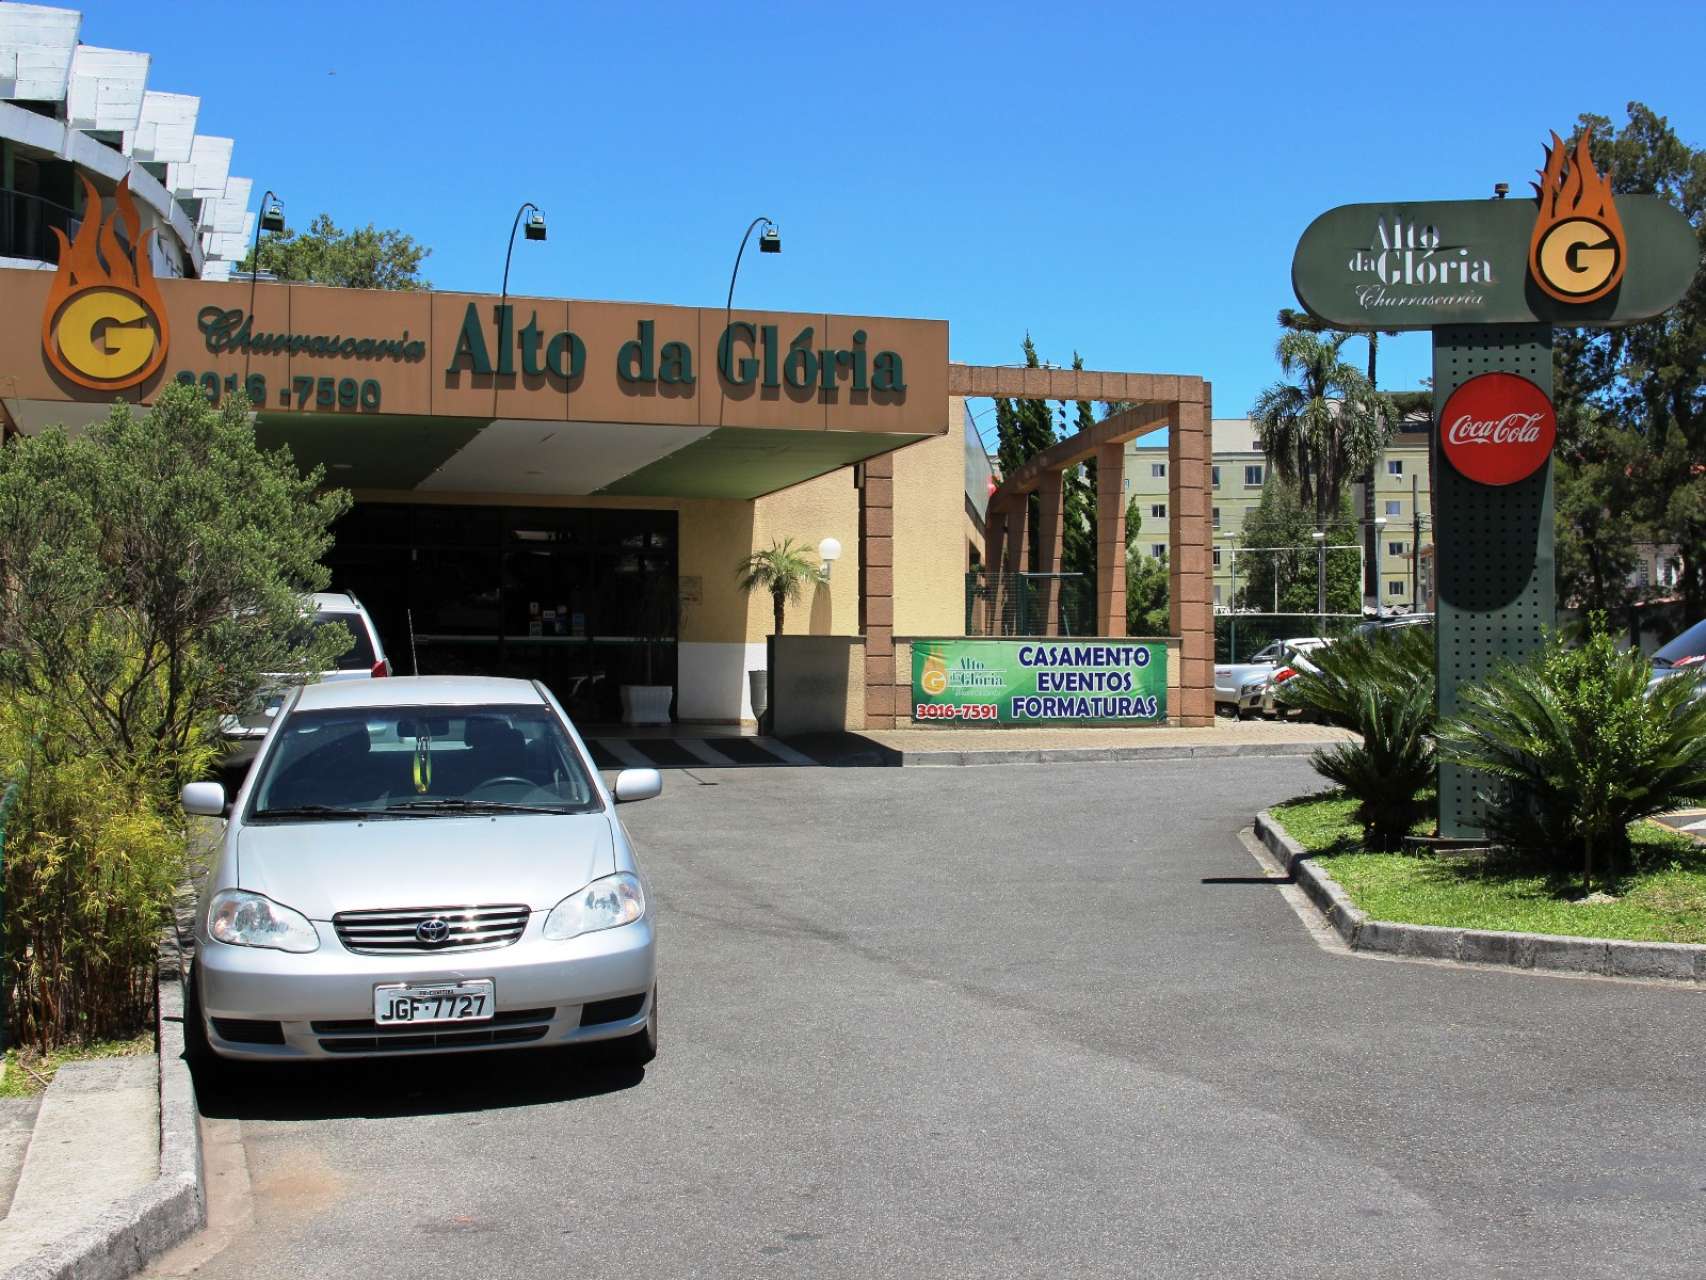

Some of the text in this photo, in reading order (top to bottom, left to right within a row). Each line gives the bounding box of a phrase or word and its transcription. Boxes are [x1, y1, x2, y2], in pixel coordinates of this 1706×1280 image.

[1371, 213, 1440, 250] Alto
[1348, 248, 1493, 285] da Glória
[1540, 221, 1616, 294] G
[1355, 284, 1484, 310] Churrascaria
[58, 292, 155, 379] G
[446, 302, 908, 392] Alto da Glória
[1448, 412, 1546, 446] Coca-Cola
[958, 656, 985, 670] Alto
[1018, 646, 1151, 667] CASAMENTO
[1037, 671, 1132, 692] EVENTOS
[916, 703, 998, 720] 3016-7591
[1012, 697, 1158, 719] FORMATURAS
